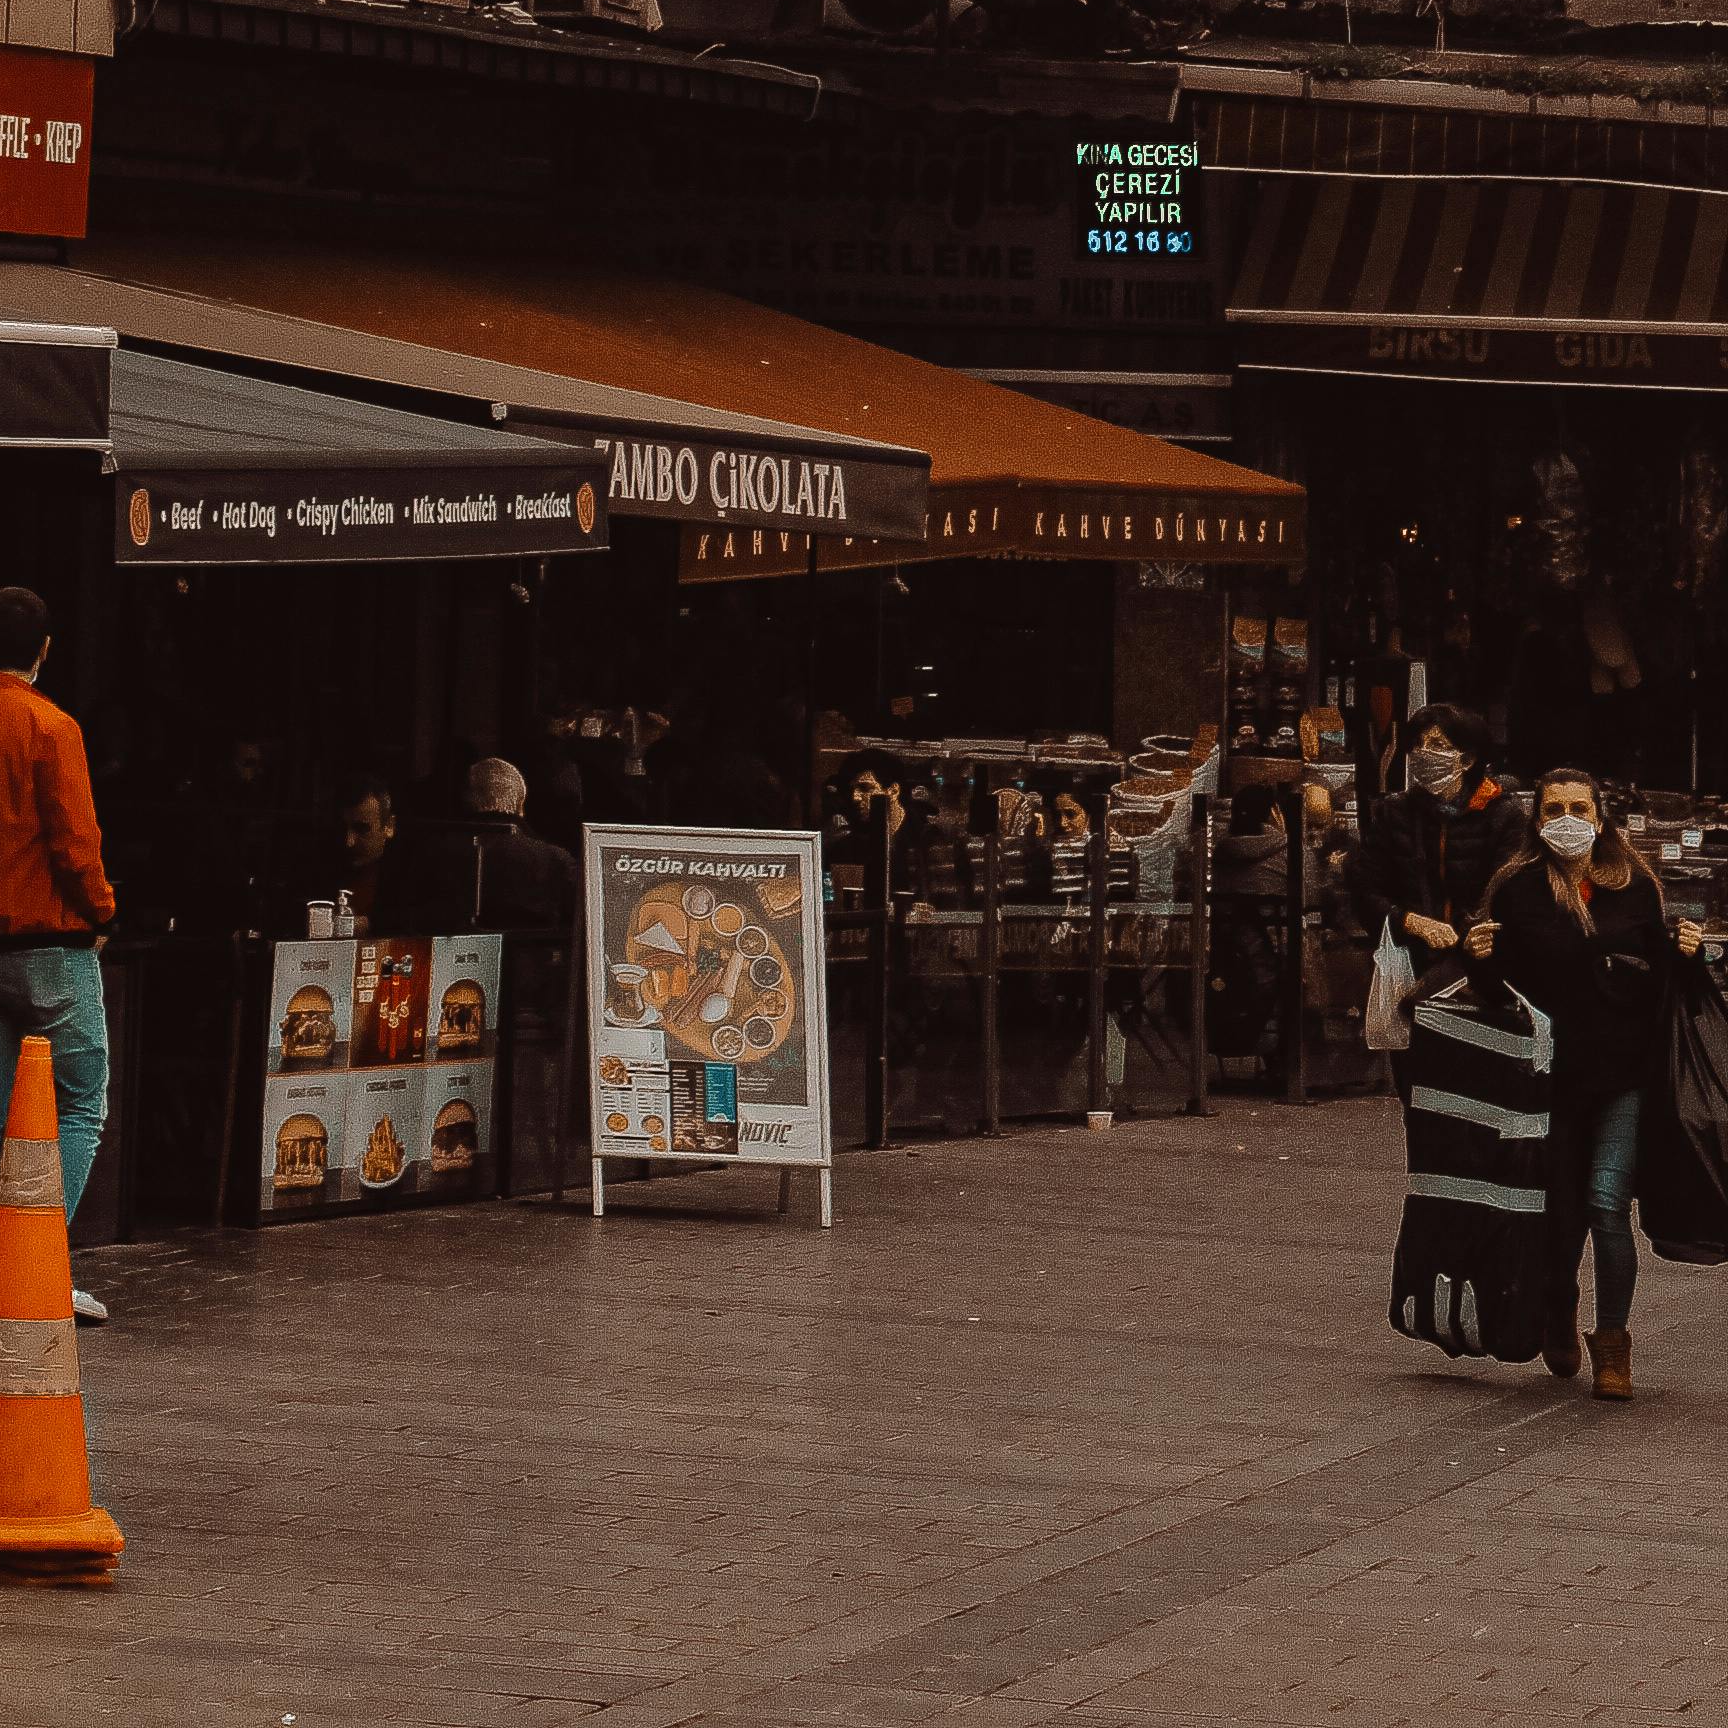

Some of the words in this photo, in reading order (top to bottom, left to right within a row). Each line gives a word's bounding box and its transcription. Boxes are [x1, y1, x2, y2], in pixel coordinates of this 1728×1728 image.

[45, 120, 82, 164] KREP
[1127, 140, 1200, 166] GECESİ
[1095, 169, 1181, 199] ÇEREZİ
[1095, 201, 1182, 224] YAPILIR
[725, 240, 1035, 280] ŞEKERLEME
[594, 438, 699, 505] AMBO
[172, 499, 204, 530] Beef
[222, 501, 247, 530] Hot
[249, 500, 276, 537] Dog
[296, 497, 339, 535] Crispy
[341, 495, 394, 526] Chicken
[413, 496, 435, 524] Mix
[436, 494, 497, 524] Sandwich
[515, 491, 572, 519] Breakfast
[1035, 512, 1132, 541] KAHVE
[1156, 512, 1285, 543] DÜNYASI
[614, 855, 684, 875] ÖZGÜR
[687, 861, 787, 879] KAHVALTI
